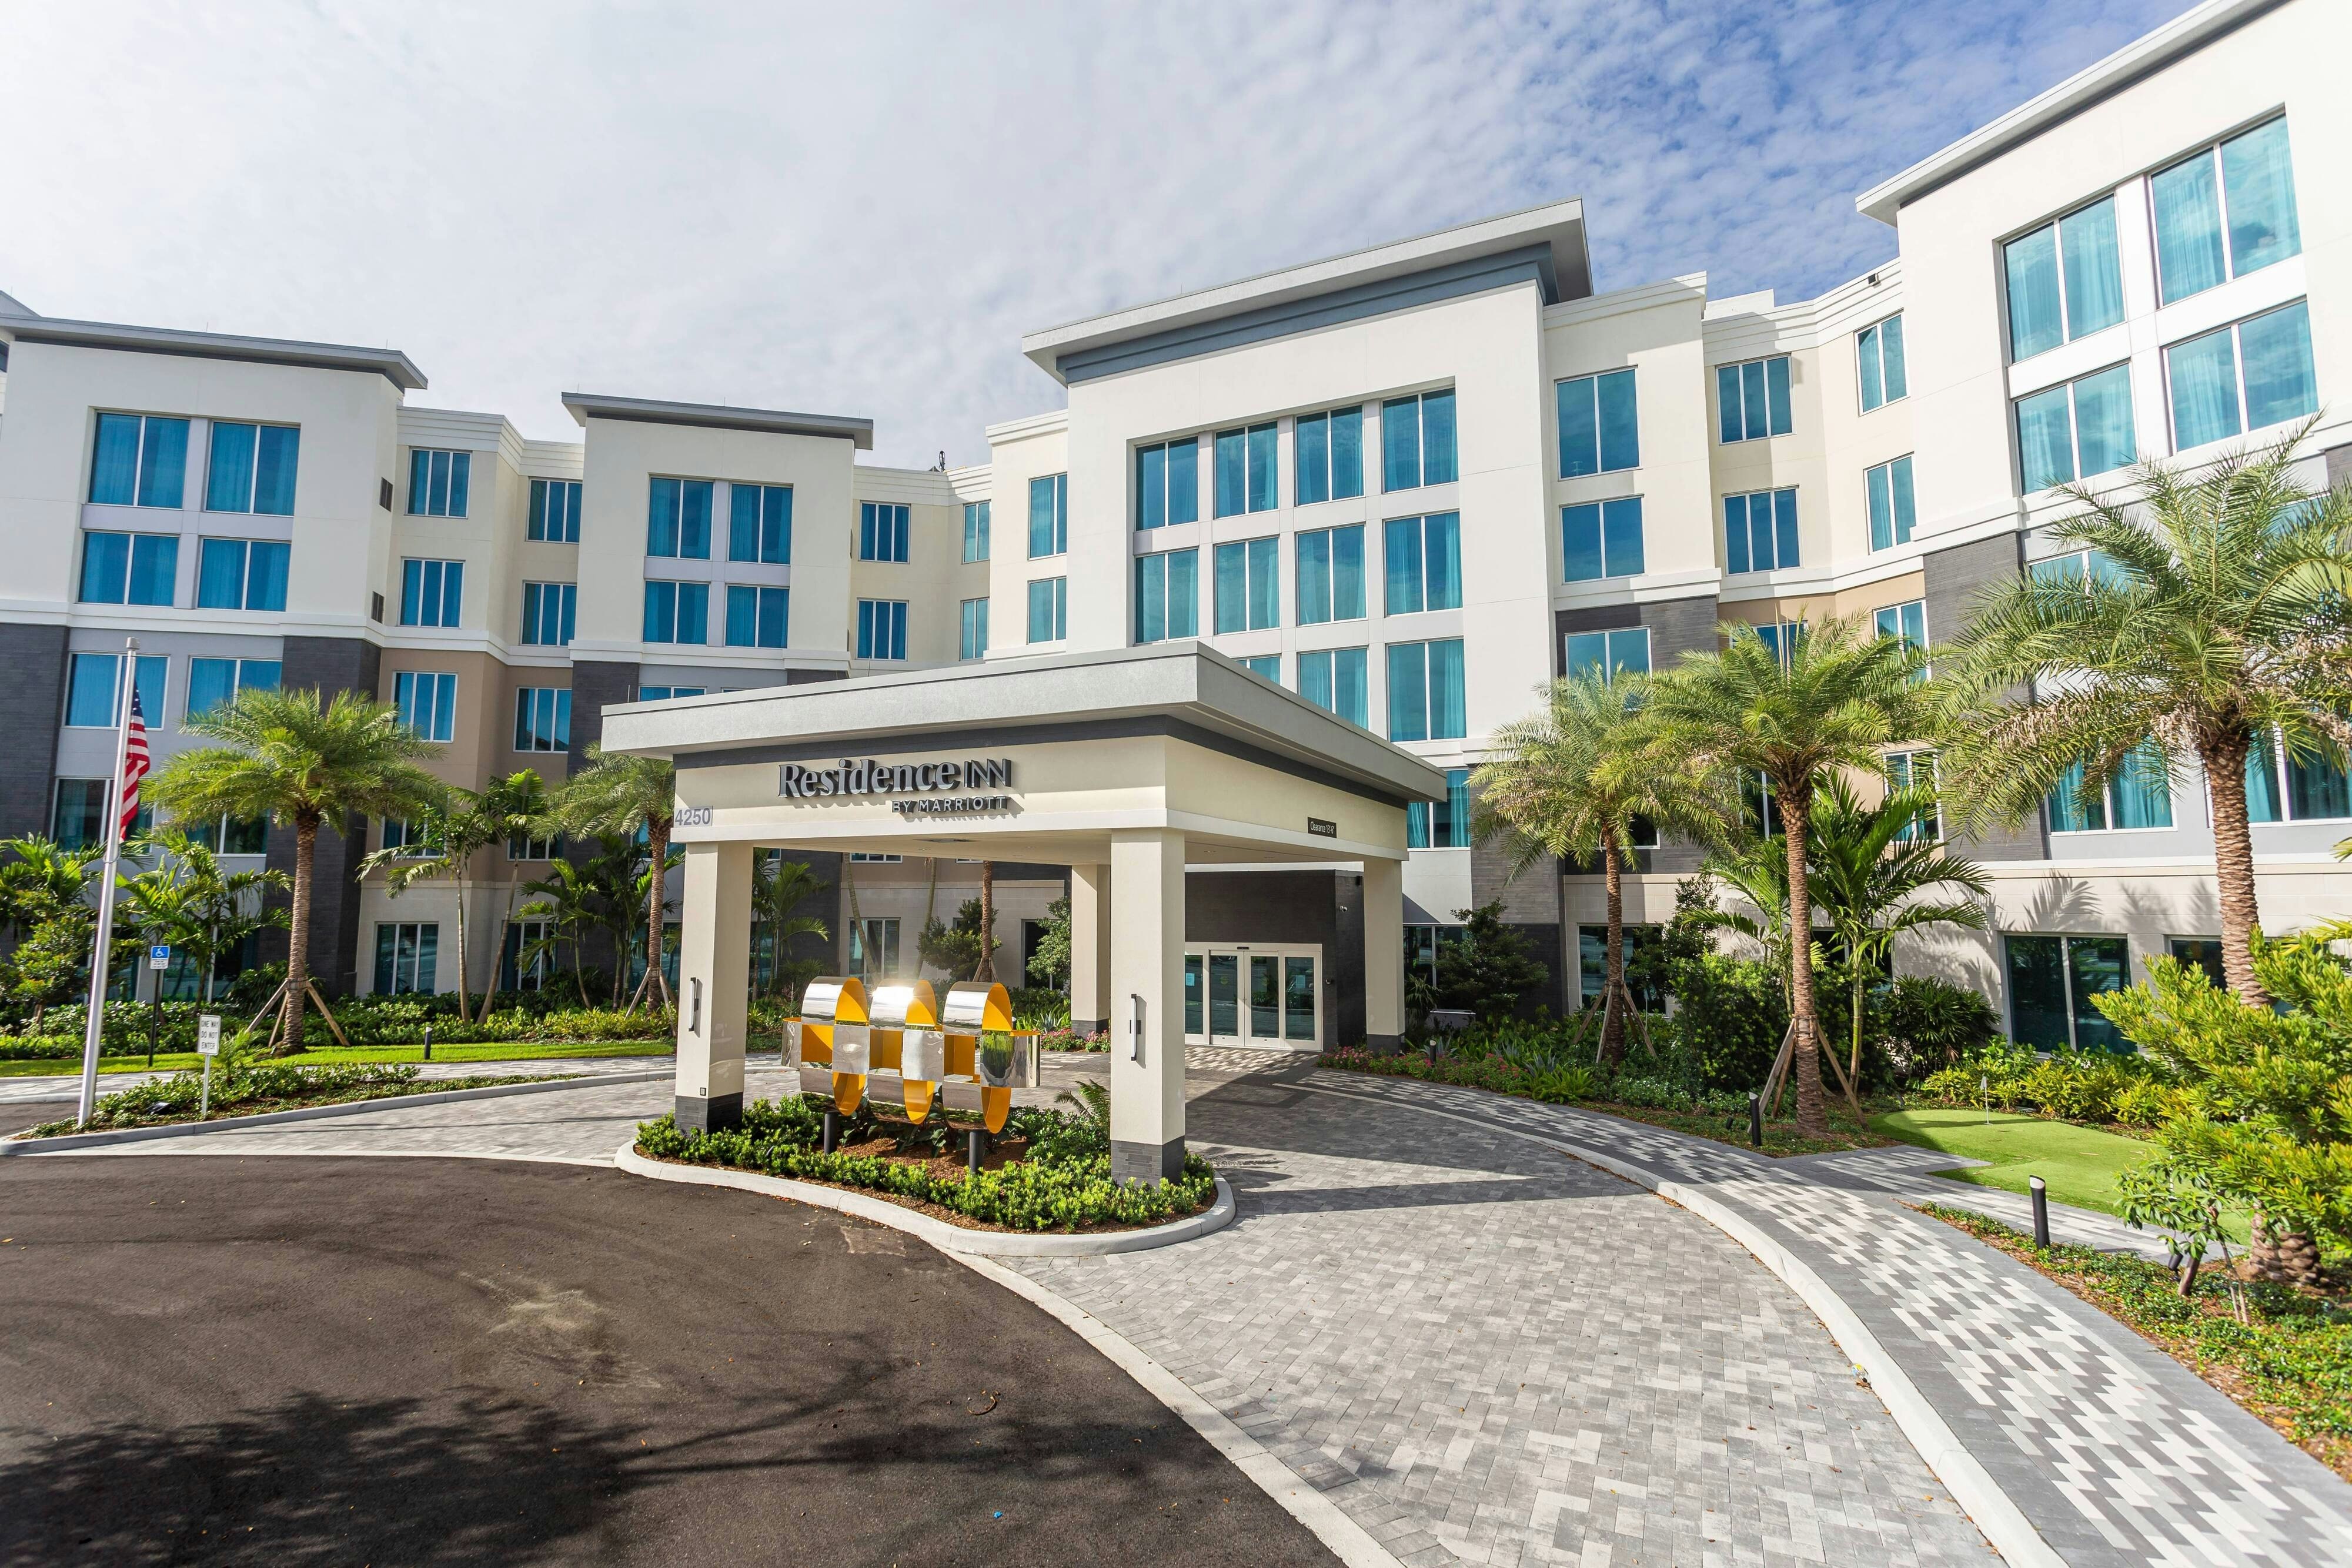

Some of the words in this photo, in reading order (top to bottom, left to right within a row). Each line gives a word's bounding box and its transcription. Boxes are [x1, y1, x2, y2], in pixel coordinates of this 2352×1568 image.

[778, 758, 960, 797] Residence
[892, 800, 917, 813] BY
[918, 796, 1011, 813] MARRIOTT
[674, 808, 711, 826] 4250
[202, 1041, 216, 1049] ENTER
